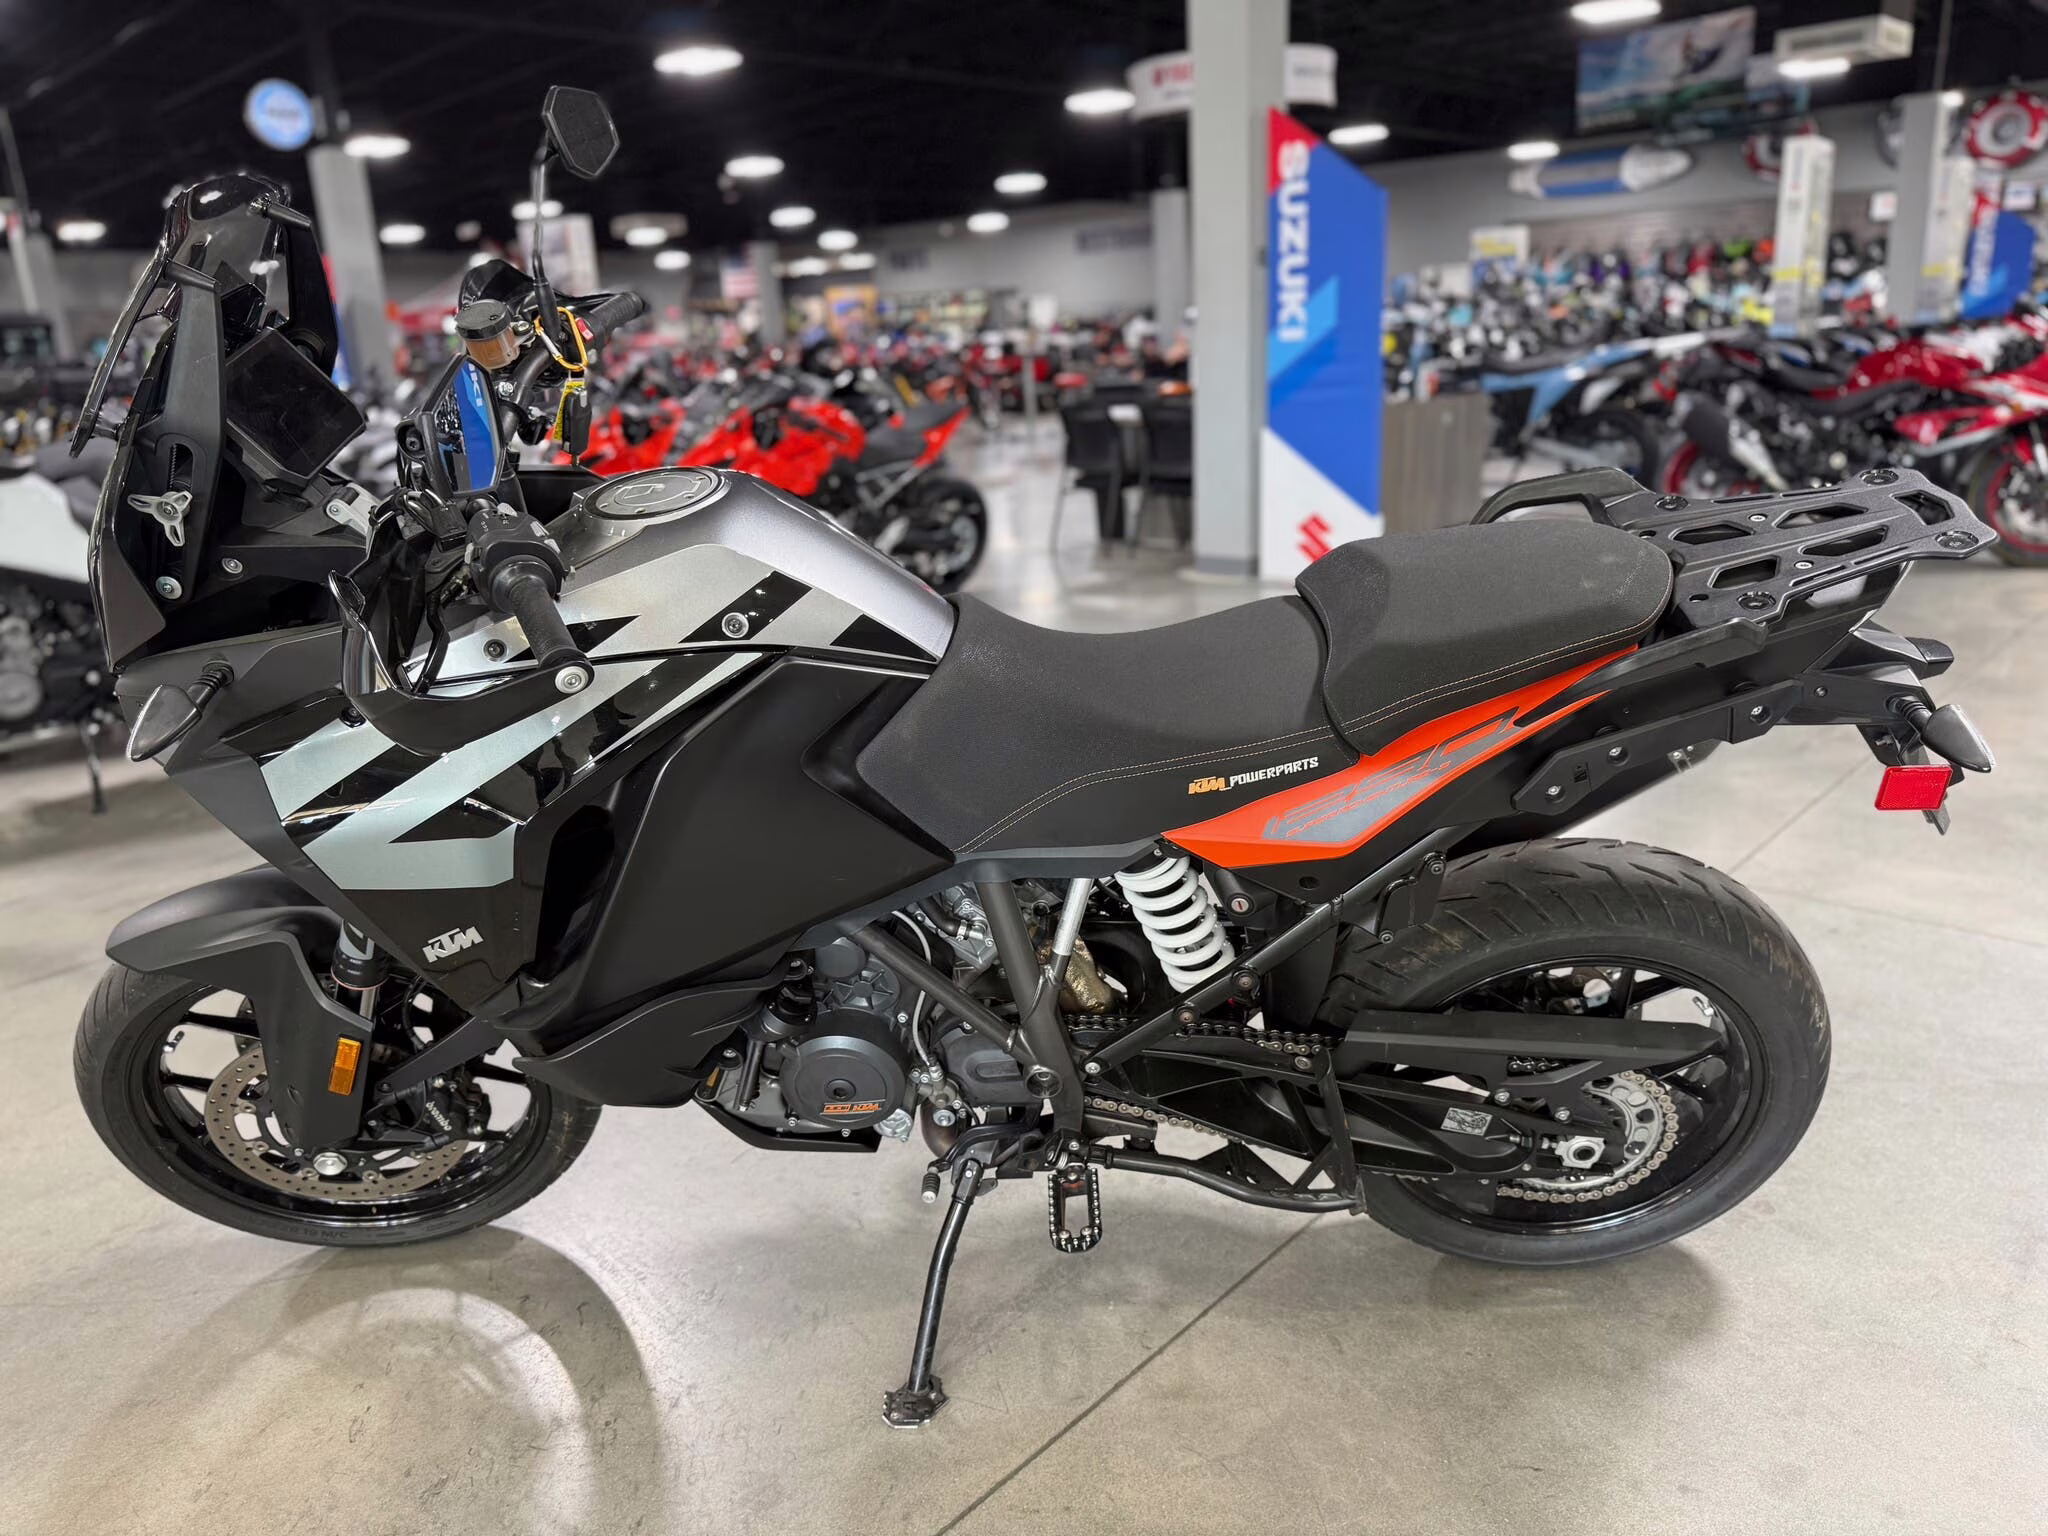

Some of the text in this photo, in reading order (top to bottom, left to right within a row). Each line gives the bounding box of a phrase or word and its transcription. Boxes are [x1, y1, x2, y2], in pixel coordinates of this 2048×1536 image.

[1277, 139, 1310, 342] SUZUKI
[1188, 776, 1226, 794] KTM
[422, 926, 484, 963] KTM
[425, 1101, 452, 1131] brembo
